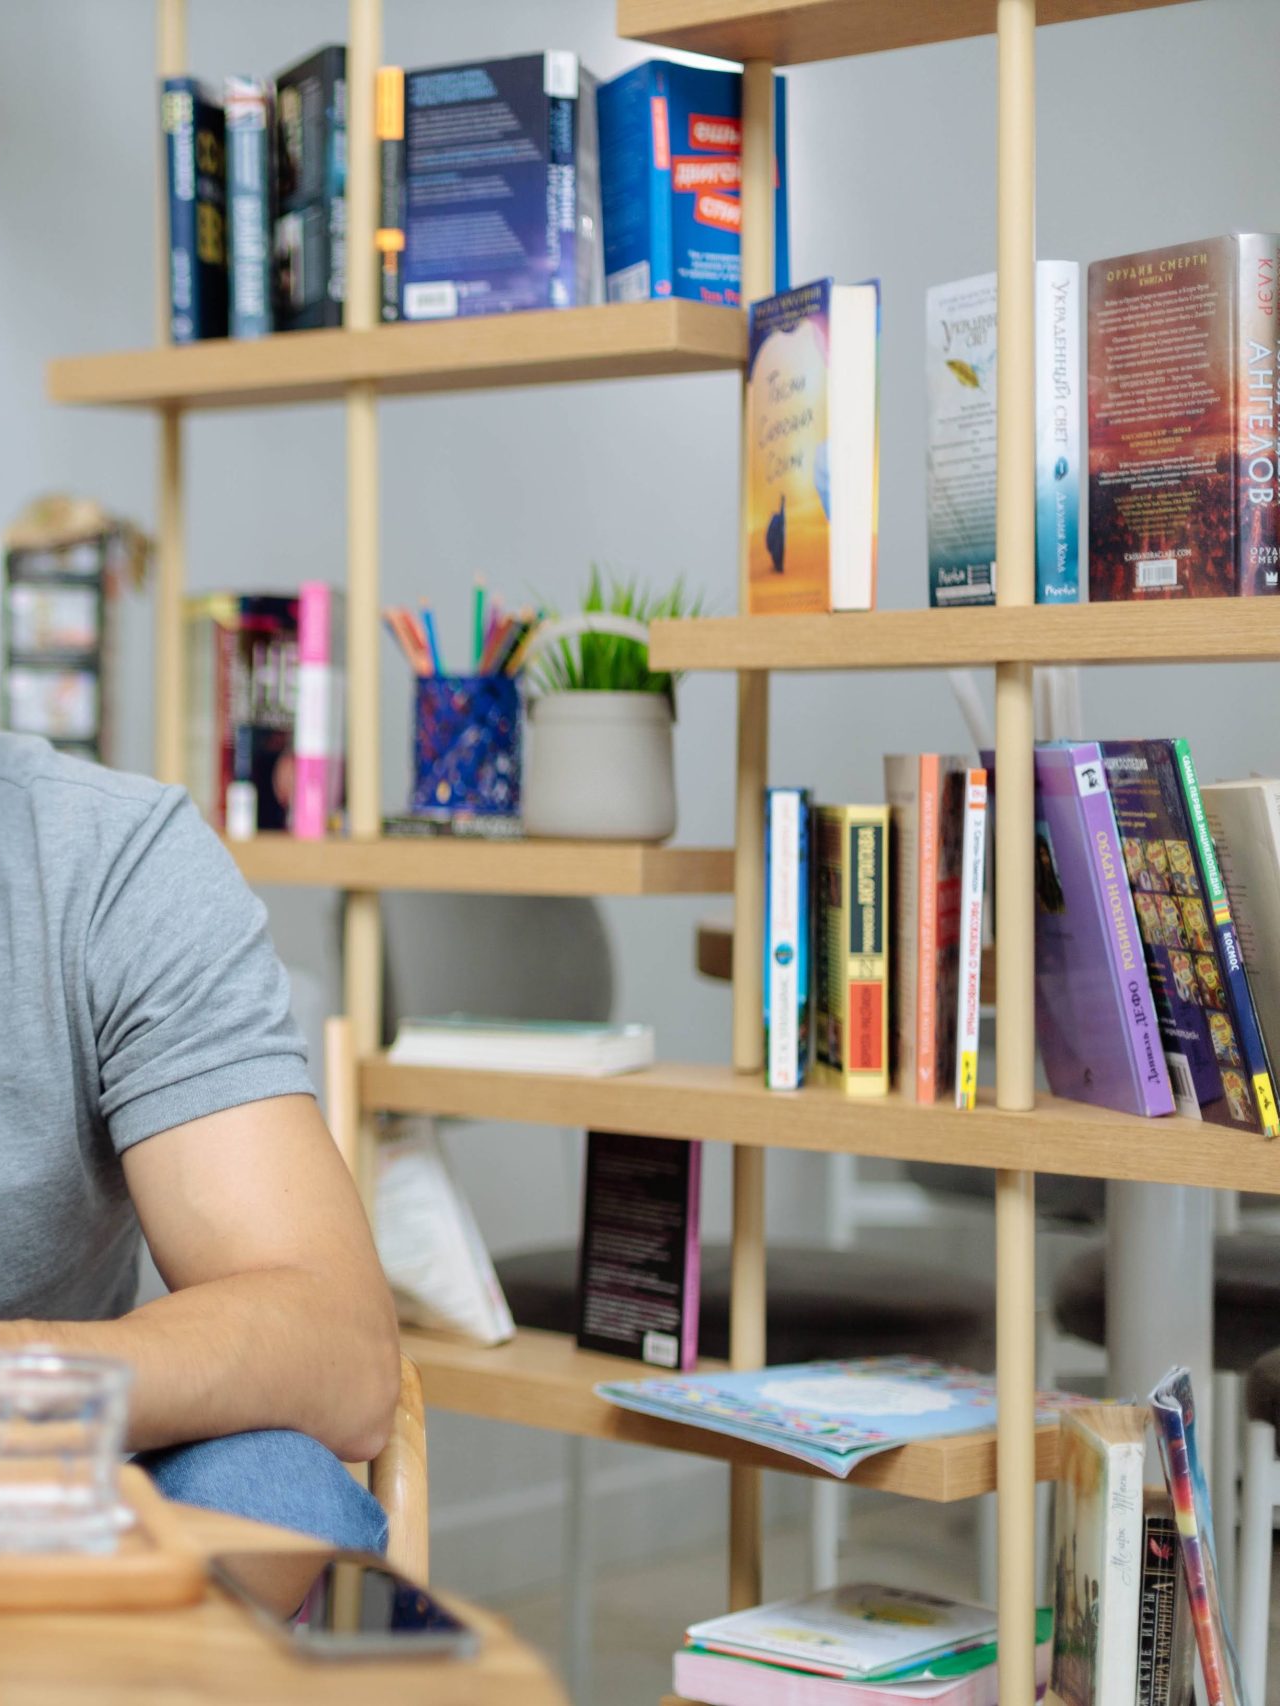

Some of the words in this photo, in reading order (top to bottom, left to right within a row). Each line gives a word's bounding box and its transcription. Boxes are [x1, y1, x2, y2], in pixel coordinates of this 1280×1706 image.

[1107, 264, 1153, 283] ОРУДИЯ
[1159, 253, 1208, 272] СМЕРТИ
[1257, 258, 1273, 316] КЛЭР
[1051, 280, 1071, 400] УКРАДЕННЫЙ
[1053, 406, 1068, 446] СВЕТ
[1247, 339, 1274, 506] АНГЕЛОВ
[1250, 546, 1280, 556] ОРУД
[1182, 755, 1195, 785] САМАЯ
[1189, 786, 1204, 821] ПЕРВАЯ
[1095, 831, 1117, 881] КРУЗО
[1196, 823, 1222, 897] ЭНЦИКЛОПЕДИЯ
[1106, 883, 1136, 971] РОБИНЗОН
[1223, 932, 1240, 972] КОСМОС
[1128, 980, 1149, 1028] ДЕФО
[1141, 1592, 1155, 1637] ИГРЫ
[1151, 1581, 1174, 1659] МАРИНИНА
